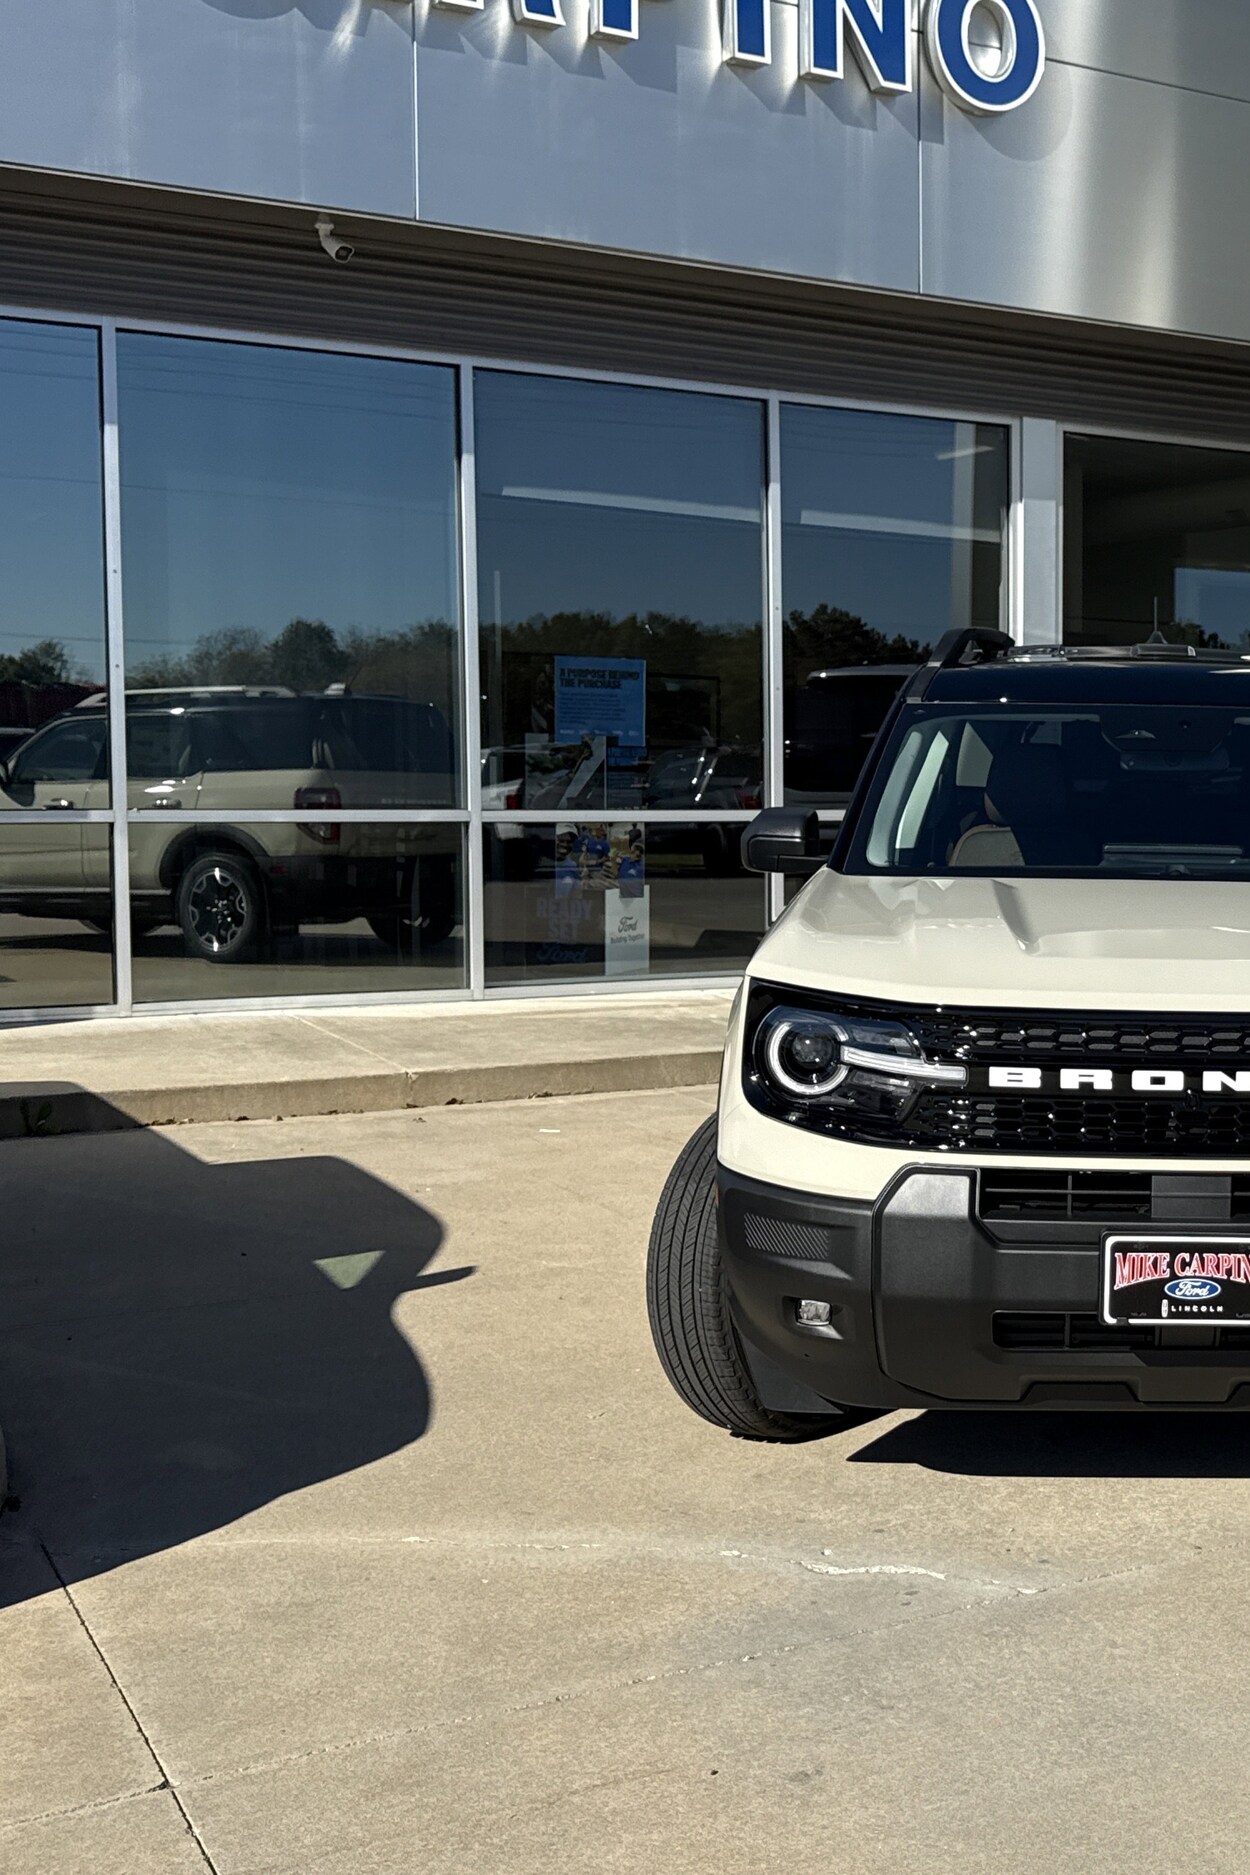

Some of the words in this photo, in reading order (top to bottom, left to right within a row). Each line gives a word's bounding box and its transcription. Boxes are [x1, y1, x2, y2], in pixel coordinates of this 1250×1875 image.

[560, 678, 575, 688] THE
[618, 916, 638, 933] Ford
[1113, 1252, 1170, 1291] MIKE
[1175, 1281, 1210, 1295] Ford
[1171, 1305, 1224, 1313] LINCOLN
